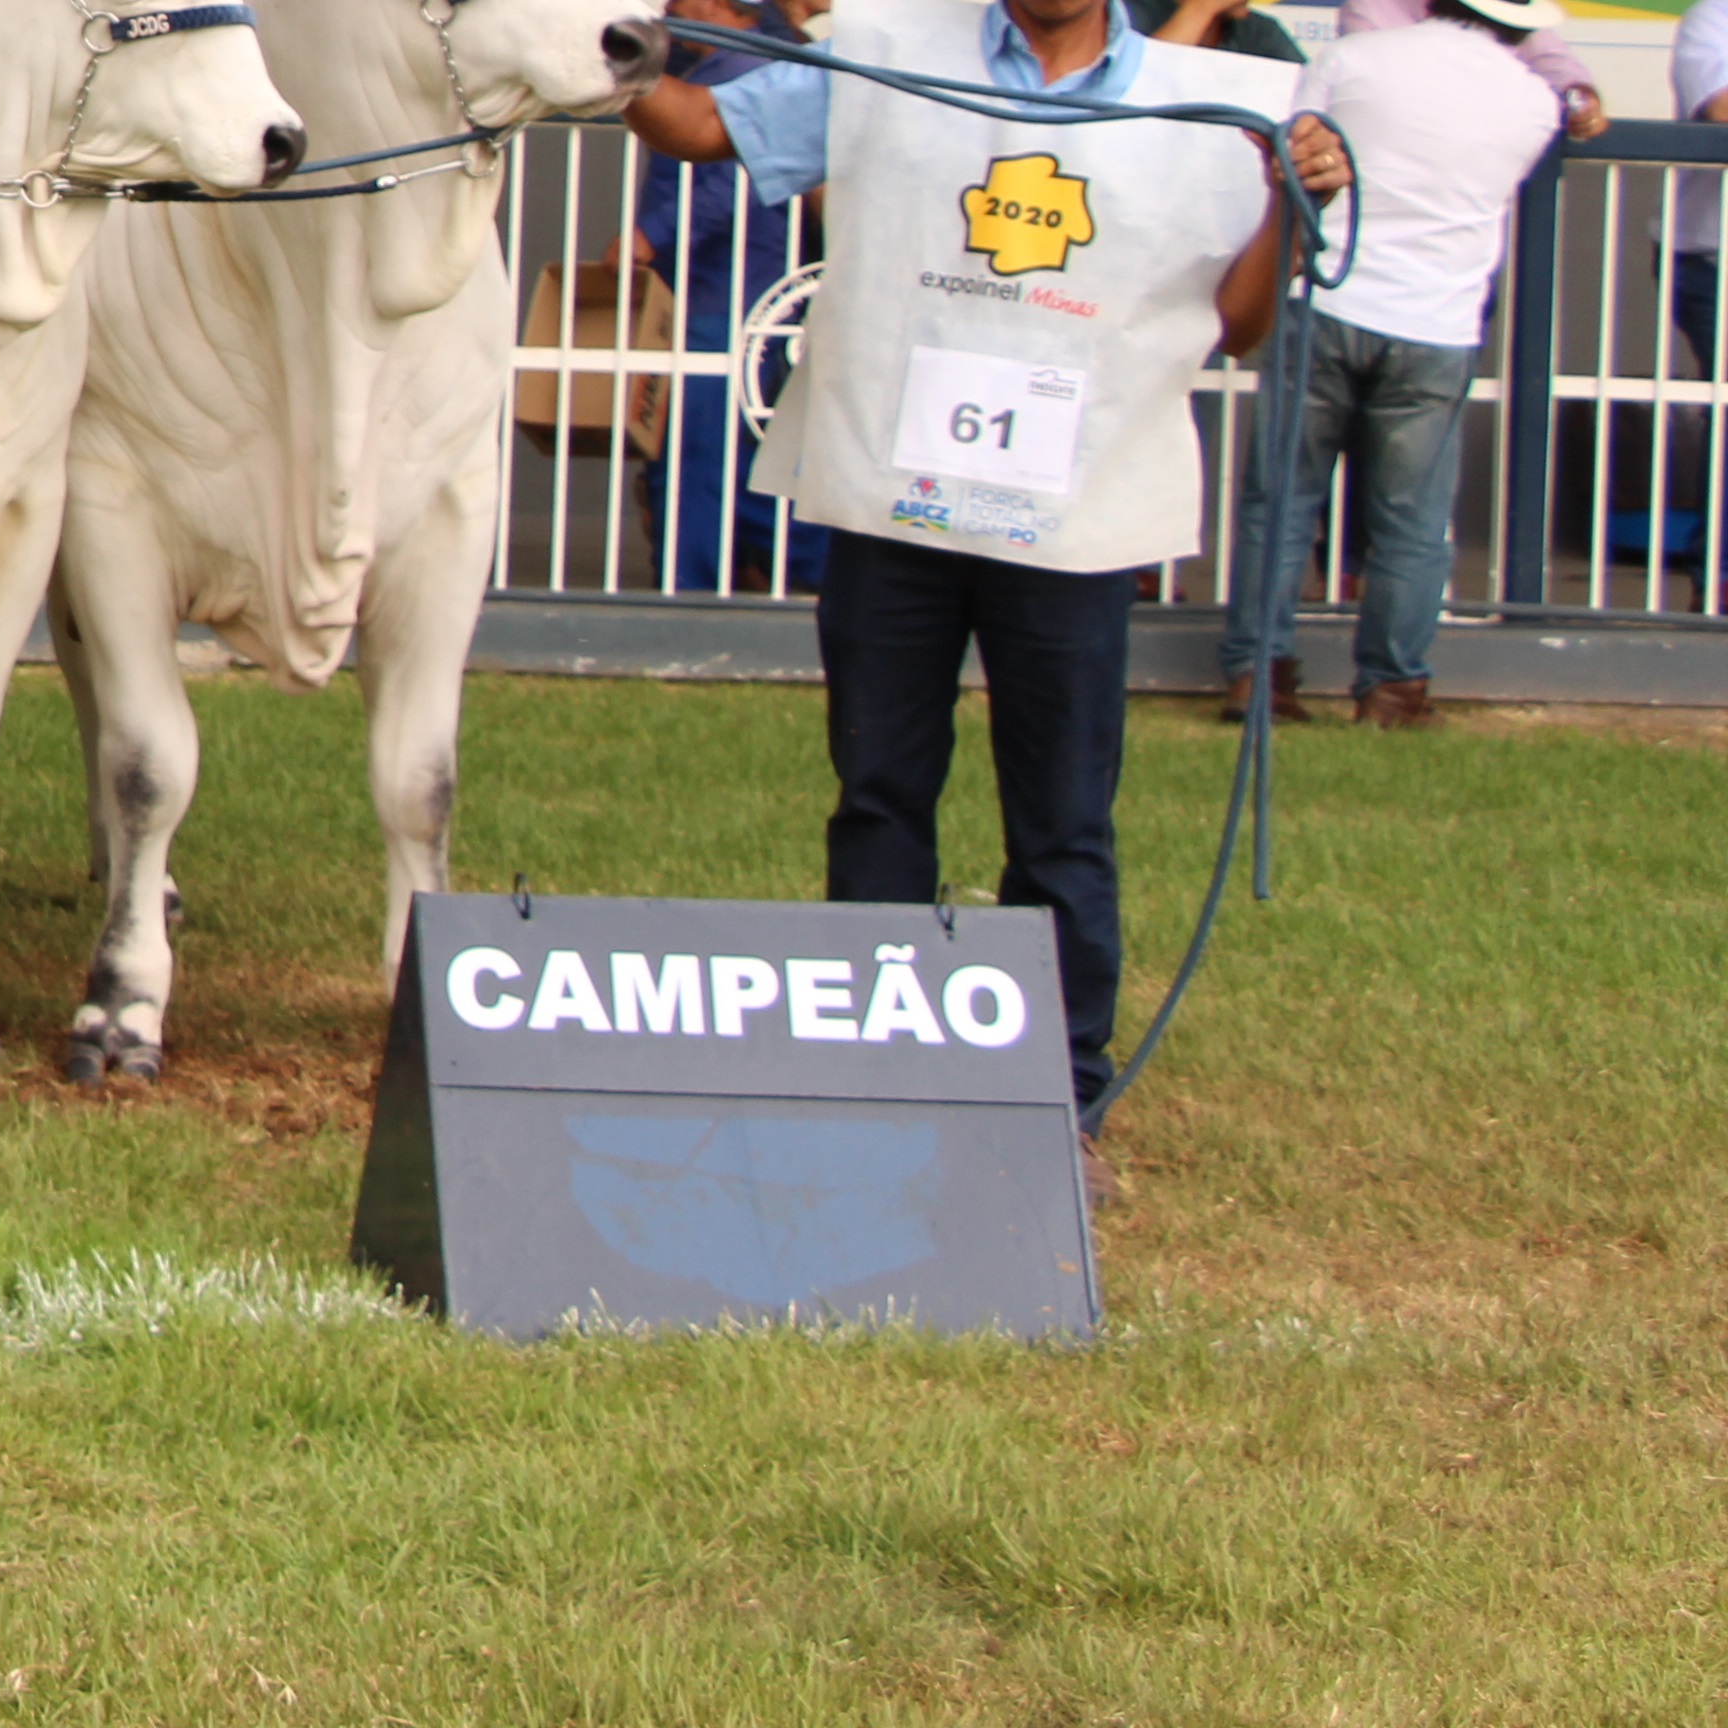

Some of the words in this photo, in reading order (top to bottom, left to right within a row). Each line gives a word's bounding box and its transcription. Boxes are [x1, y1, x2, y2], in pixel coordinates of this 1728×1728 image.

[127, 13, 171, 39] JCDG
[984, 196, 1063, 229] 2020
[920, 270, 1023, 302] expoinel
[1024, 286, 1100, 318] Minas
[949, 401, 1016, 451] 61
[892, 498, 952, 522] ABCZ
[446, 943, 1028, 1049] CAMPEÃO
